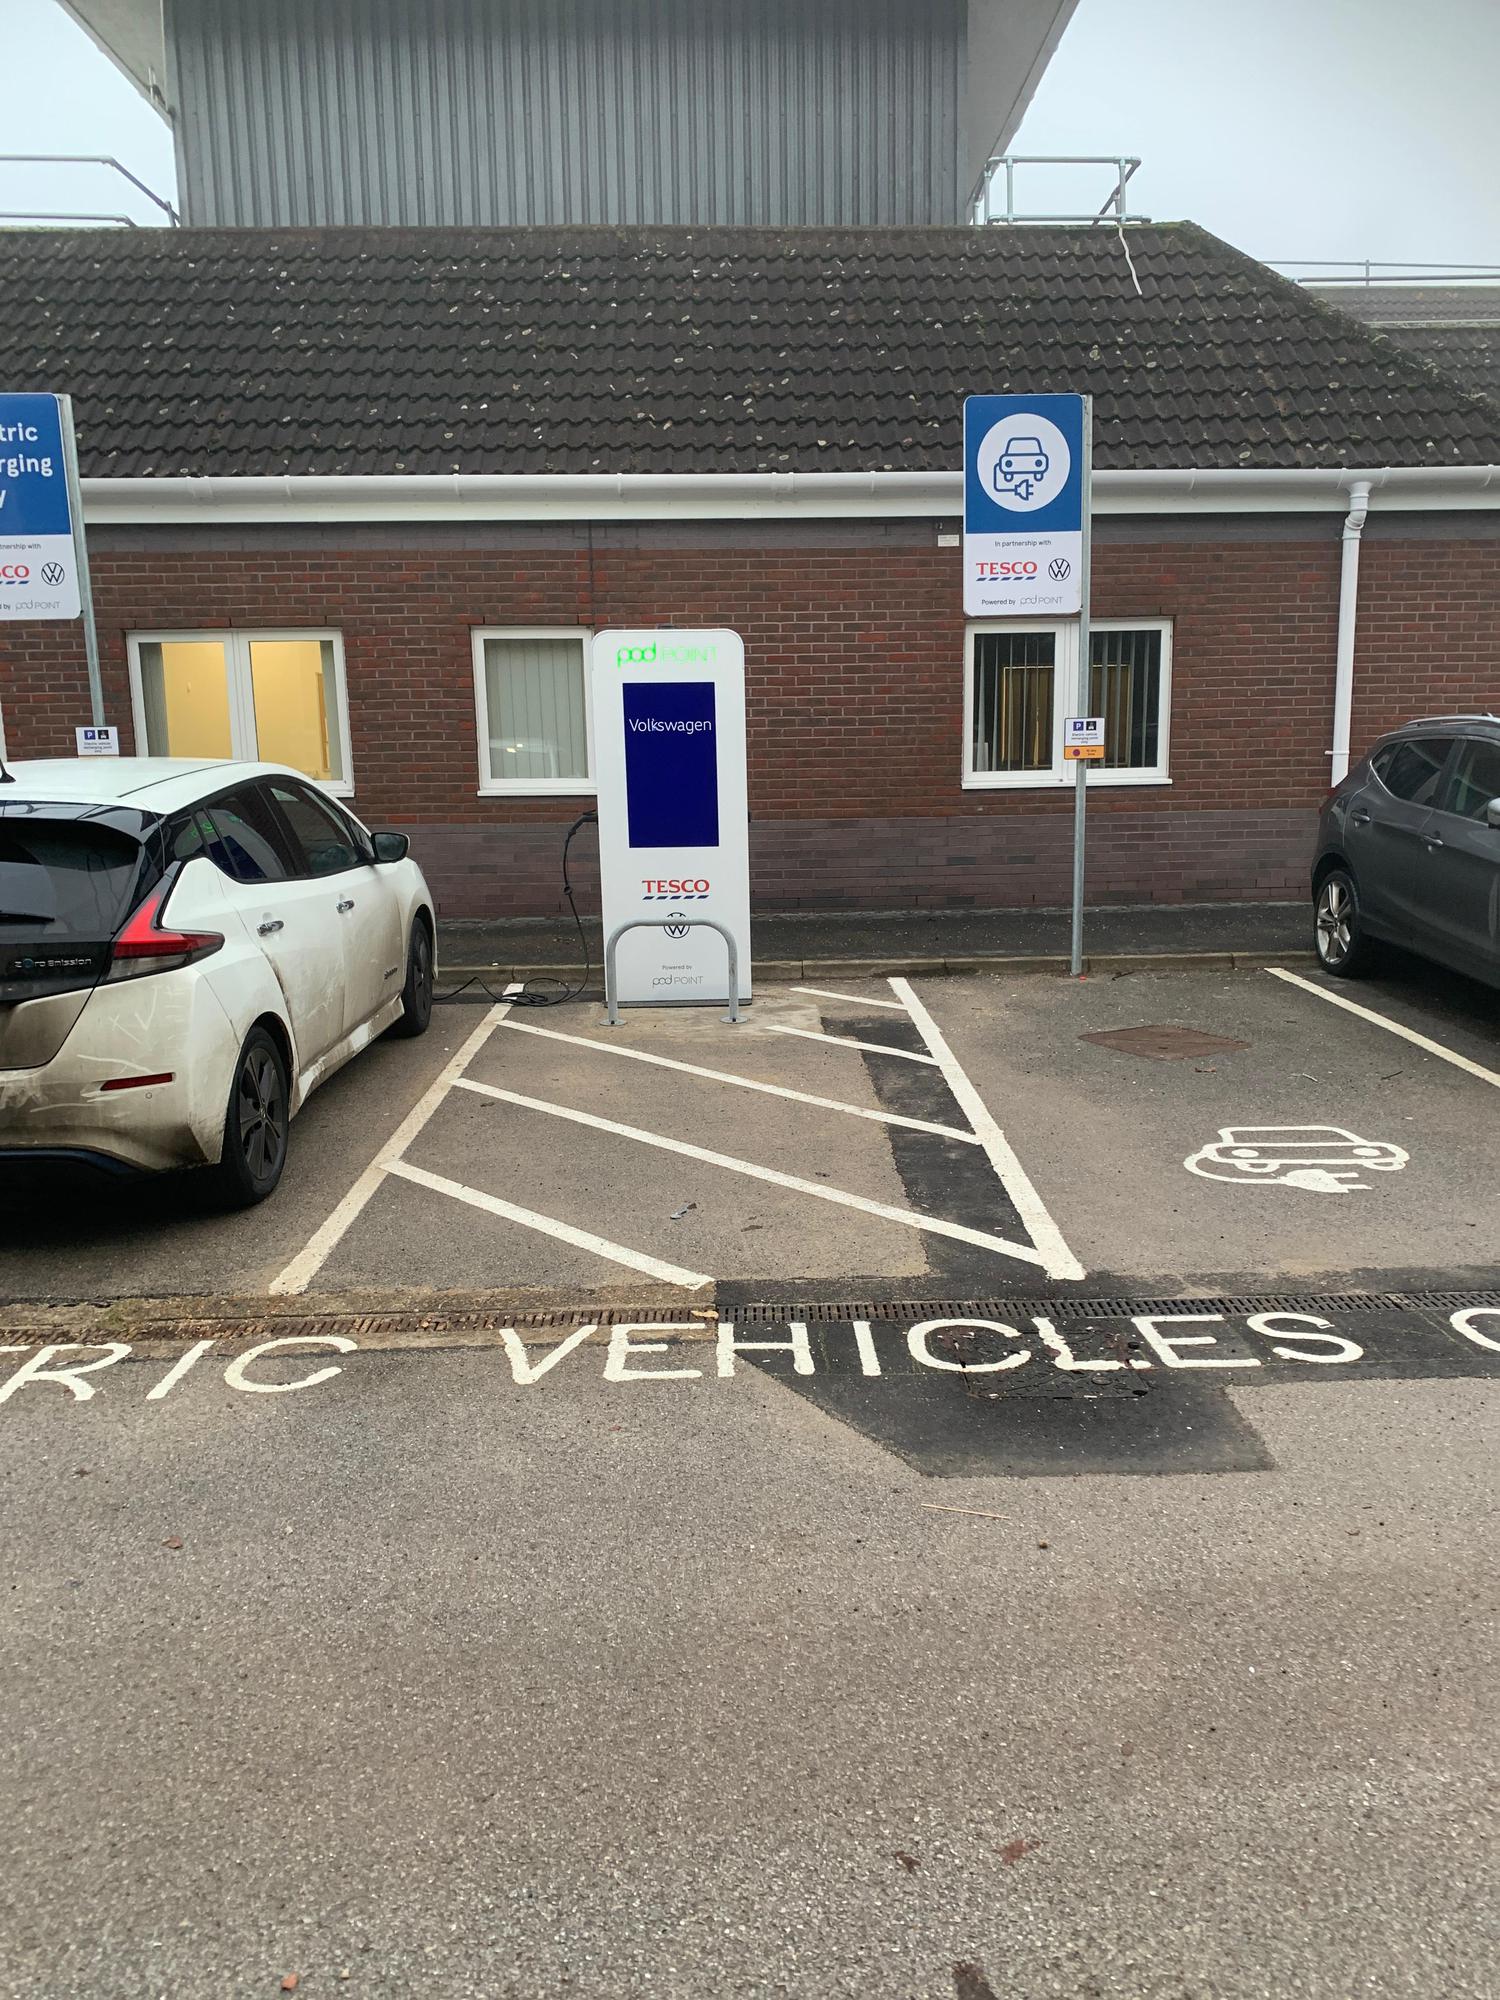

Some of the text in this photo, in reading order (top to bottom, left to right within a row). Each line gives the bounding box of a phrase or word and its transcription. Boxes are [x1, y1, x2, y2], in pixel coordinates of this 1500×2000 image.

[1002, 540, 1038, 548] partnership
[0, 565, 30, 578] CO
[975, 561, 1038, 575] TESCO
[1038, 597, 1063, 605] POINT
[617, 640, 717, 670] pod POINT
[628, 718, 712, 735] Volkswagen
[642, 880, 710, 893] TESCO
[652, 975, 703, 988] pod POINT
[498, 1311, 1364, 1386] VEHICLES
